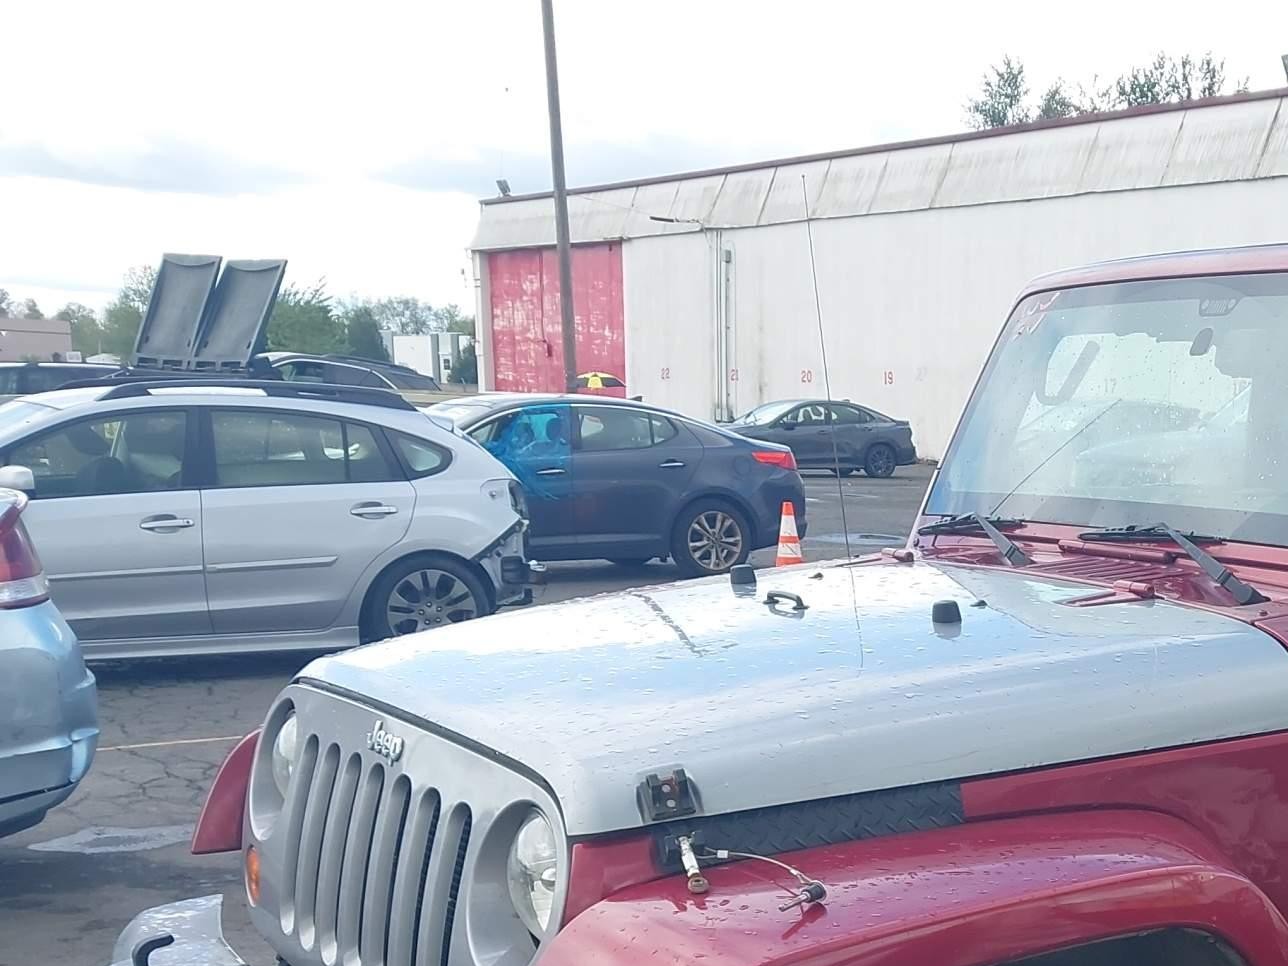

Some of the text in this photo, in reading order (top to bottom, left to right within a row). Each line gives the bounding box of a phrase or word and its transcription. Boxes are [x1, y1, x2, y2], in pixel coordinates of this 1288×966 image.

[660, 367, 670, 380] 22
[730, 369, 739, 381] 21
[801, 370, 812, 382] 20
[884, 371, 893, 384] 19
[367, 720, 404, 767] Jeep
